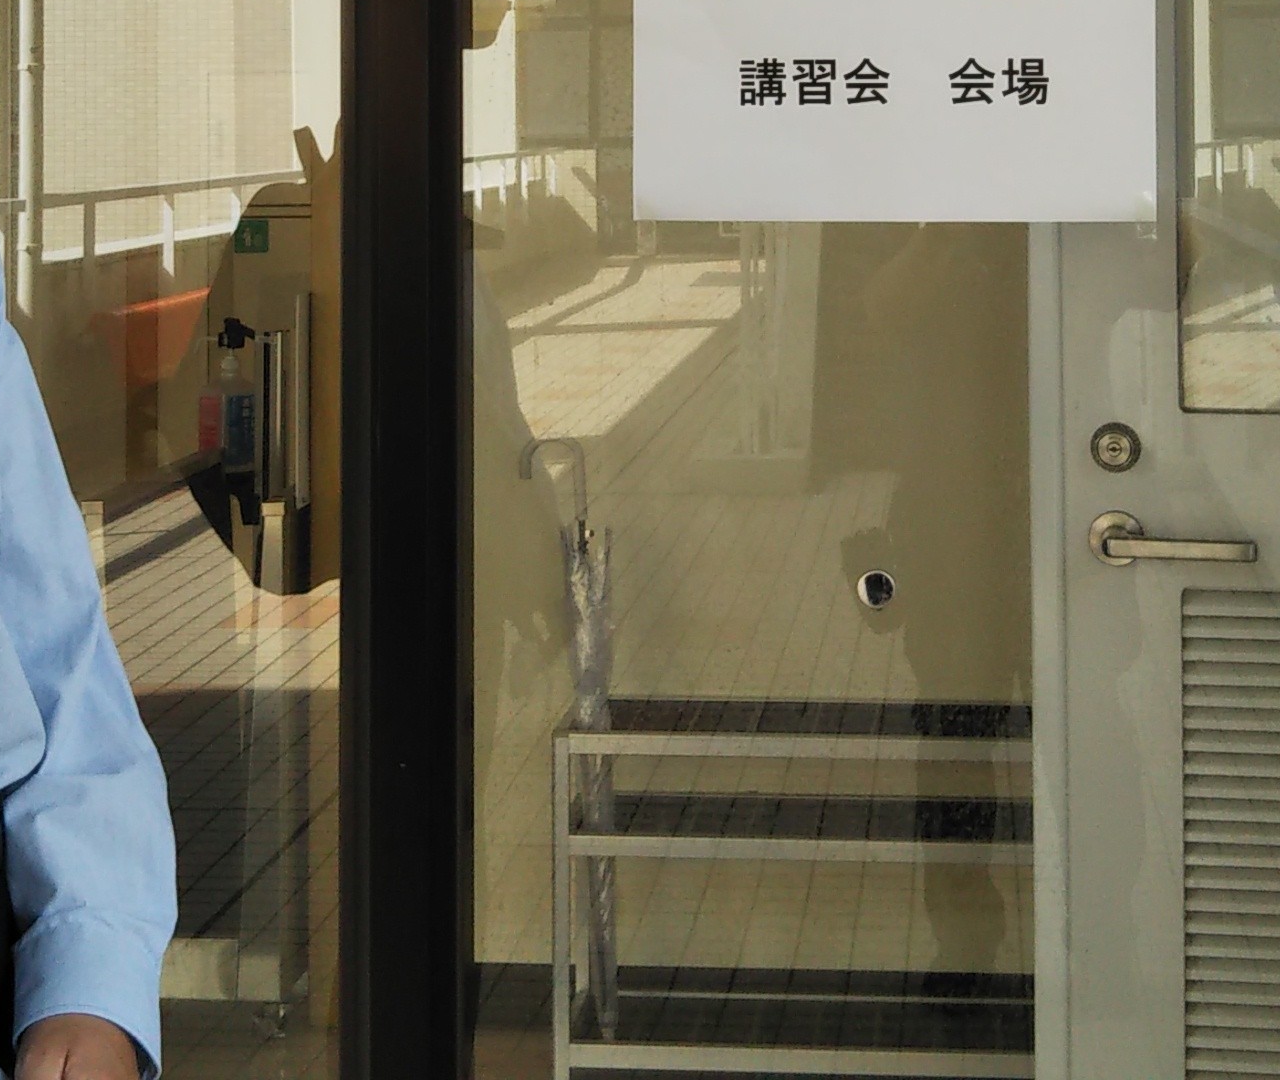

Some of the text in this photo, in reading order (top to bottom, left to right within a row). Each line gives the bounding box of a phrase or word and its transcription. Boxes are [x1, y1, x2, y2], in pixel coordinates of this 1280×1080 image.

[739, 57, 1050, 106] 講習会 会場
